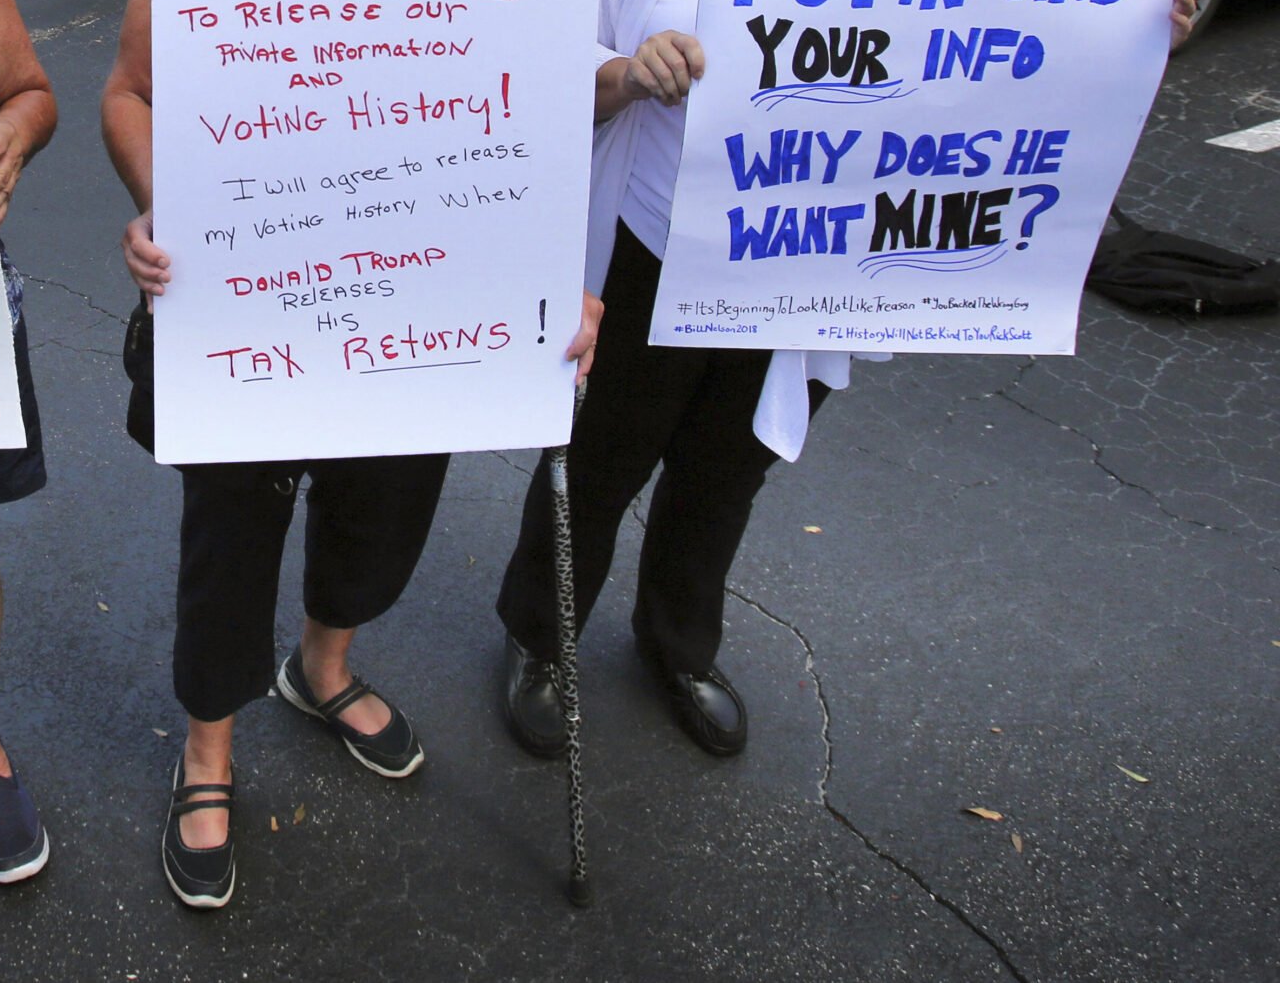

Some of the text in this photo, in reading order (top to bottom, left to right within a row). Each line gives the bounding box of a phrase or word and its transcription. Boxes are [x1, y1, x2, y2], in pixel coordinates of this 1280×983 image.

[745, 14, 1045, 90] YOUR INFO
[289, 72, 343, 89] AND
[222, 178, 256, 200] I
[320, 166, 393, 196] agree
[398, 156, 423, 177] to
[724, 129, 1071, 192] WHY DOES HE
[205, 226, 235, 251] my
[727, 184, 1060, 262] WANT MINE?
[340, 247, 447, 275] TRUMP
[206, 343, 305, 378] TAX
